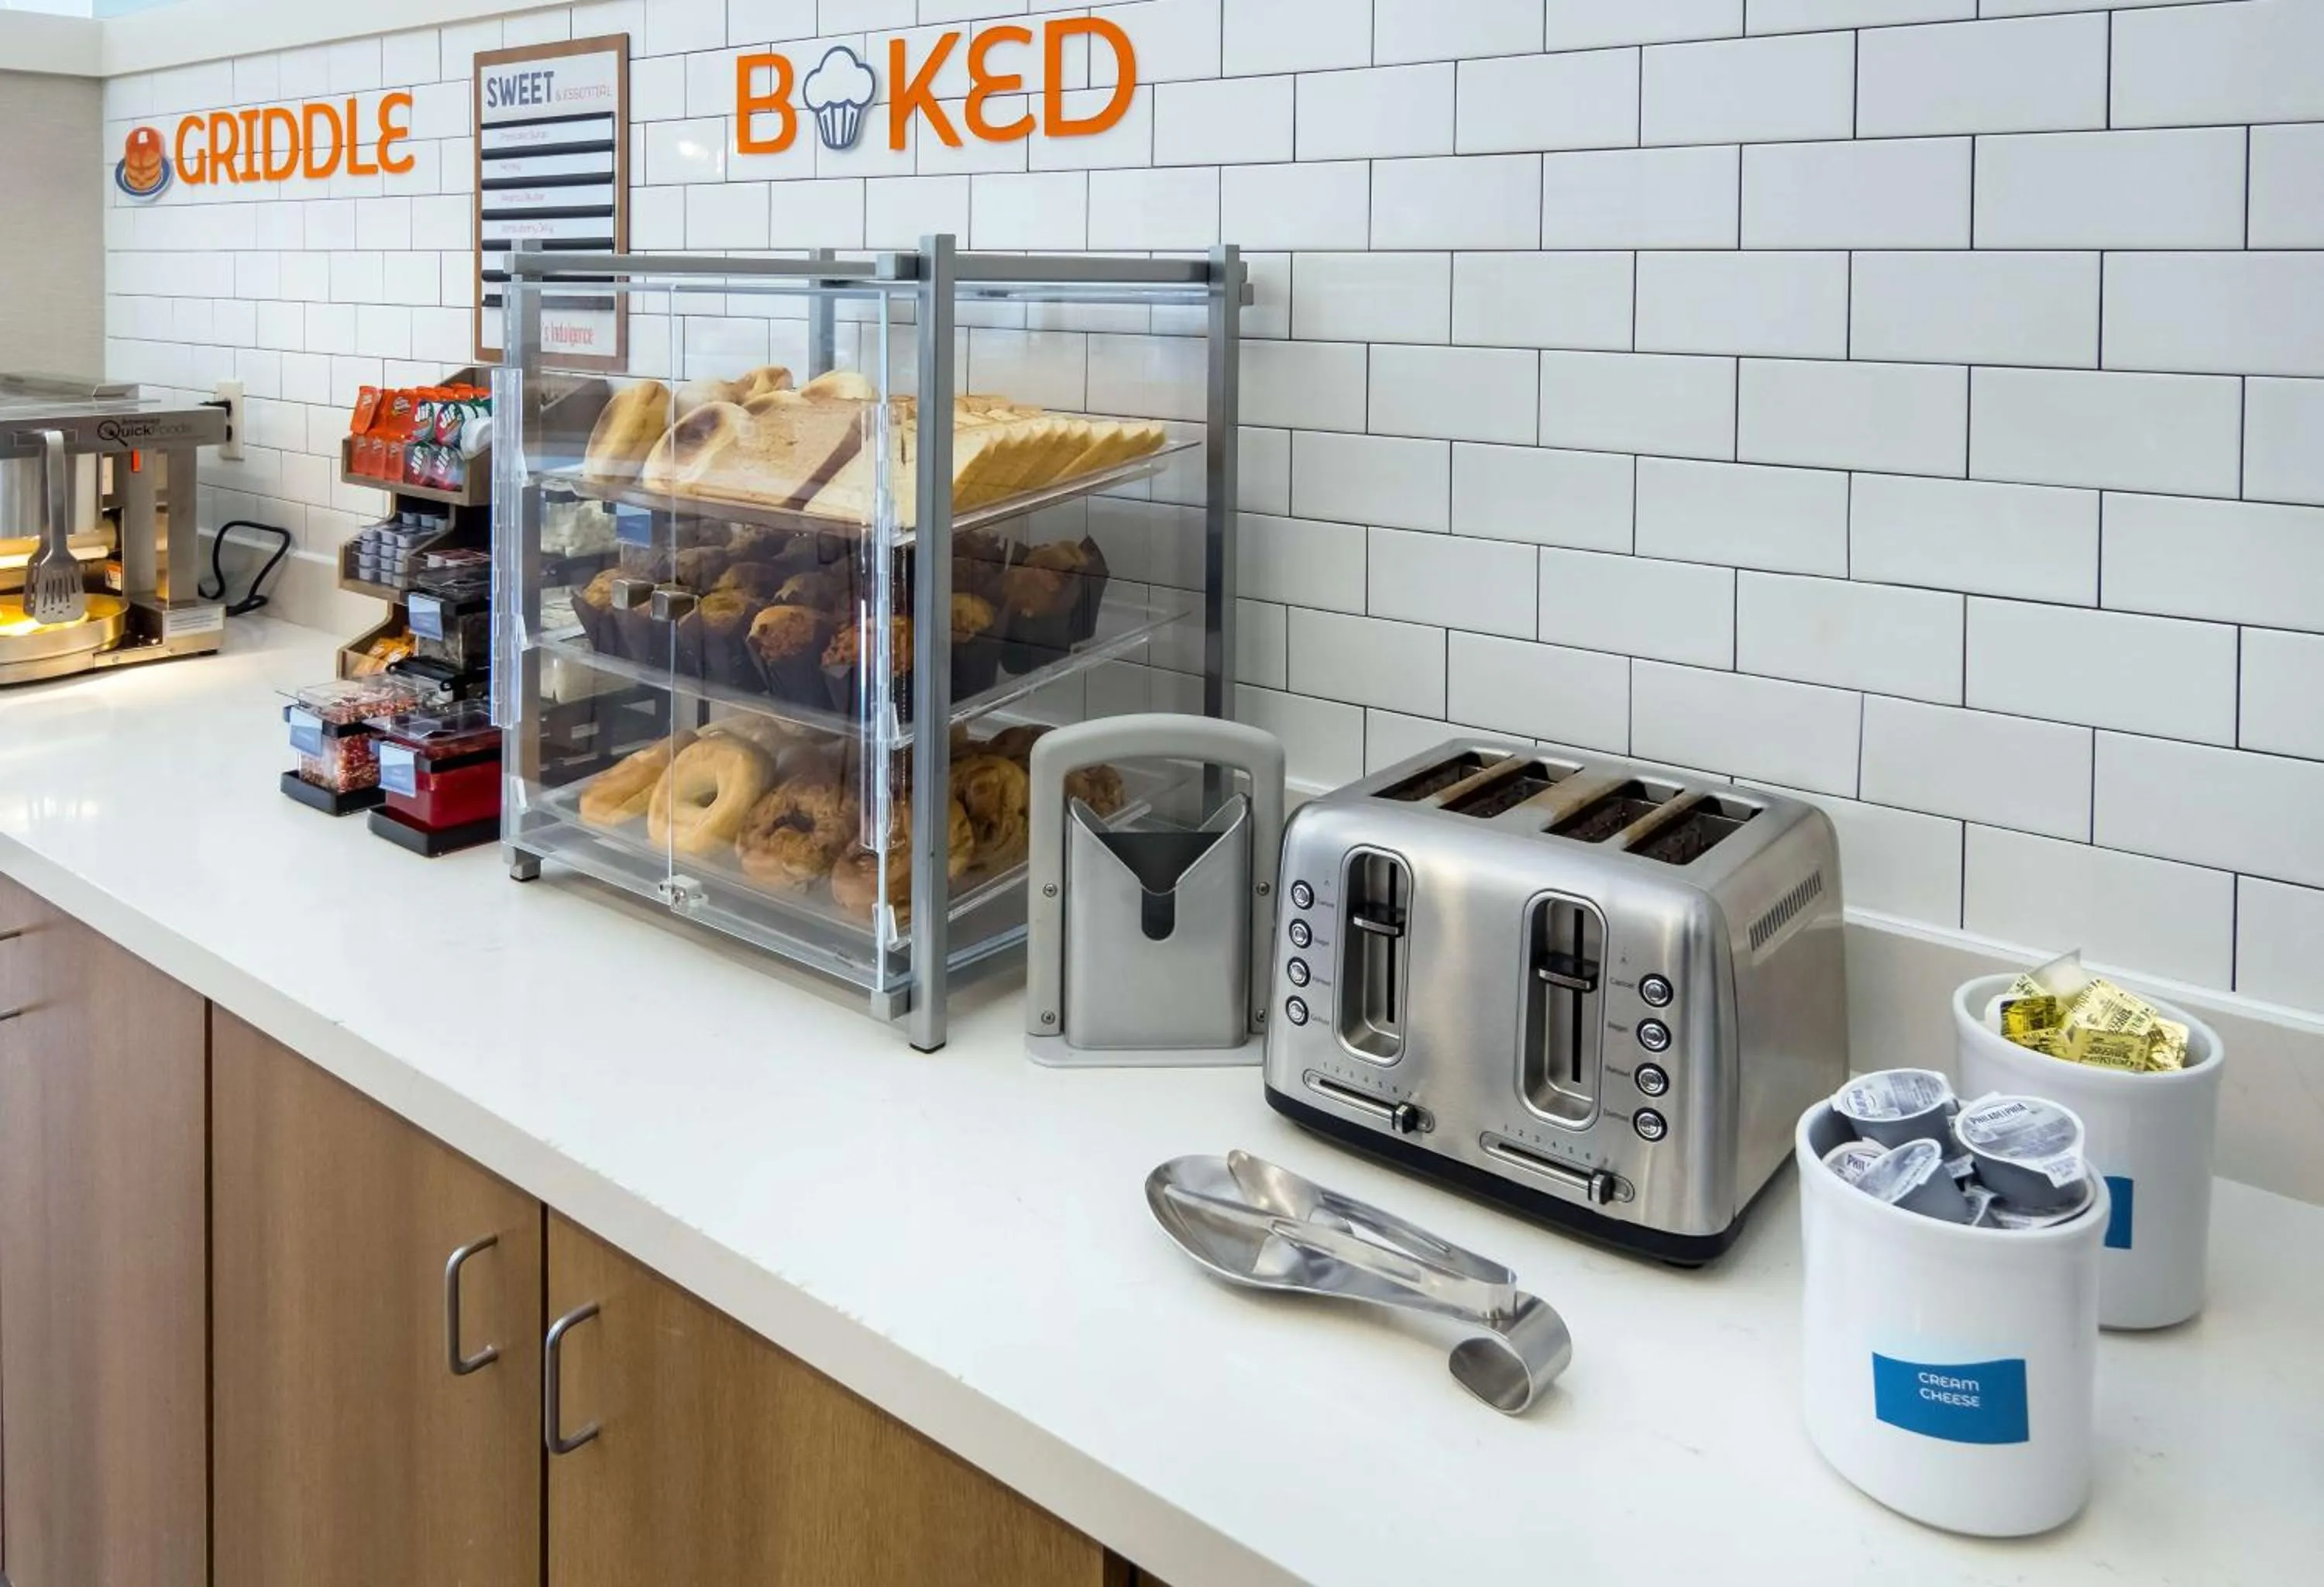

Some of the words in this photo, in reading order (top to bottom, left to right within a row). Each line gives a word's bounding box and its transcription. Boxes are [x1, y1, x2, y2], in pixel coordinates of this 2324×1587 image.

[486, 71, 555, 108] SWEET
[737, 16, 1137, 155] BKED
[175, 91, 416, 184] GRIDDLE
[1918, 1372, 1980, 1392] CREAM
[1919, 1388, 1981, 1408] CHEESE
